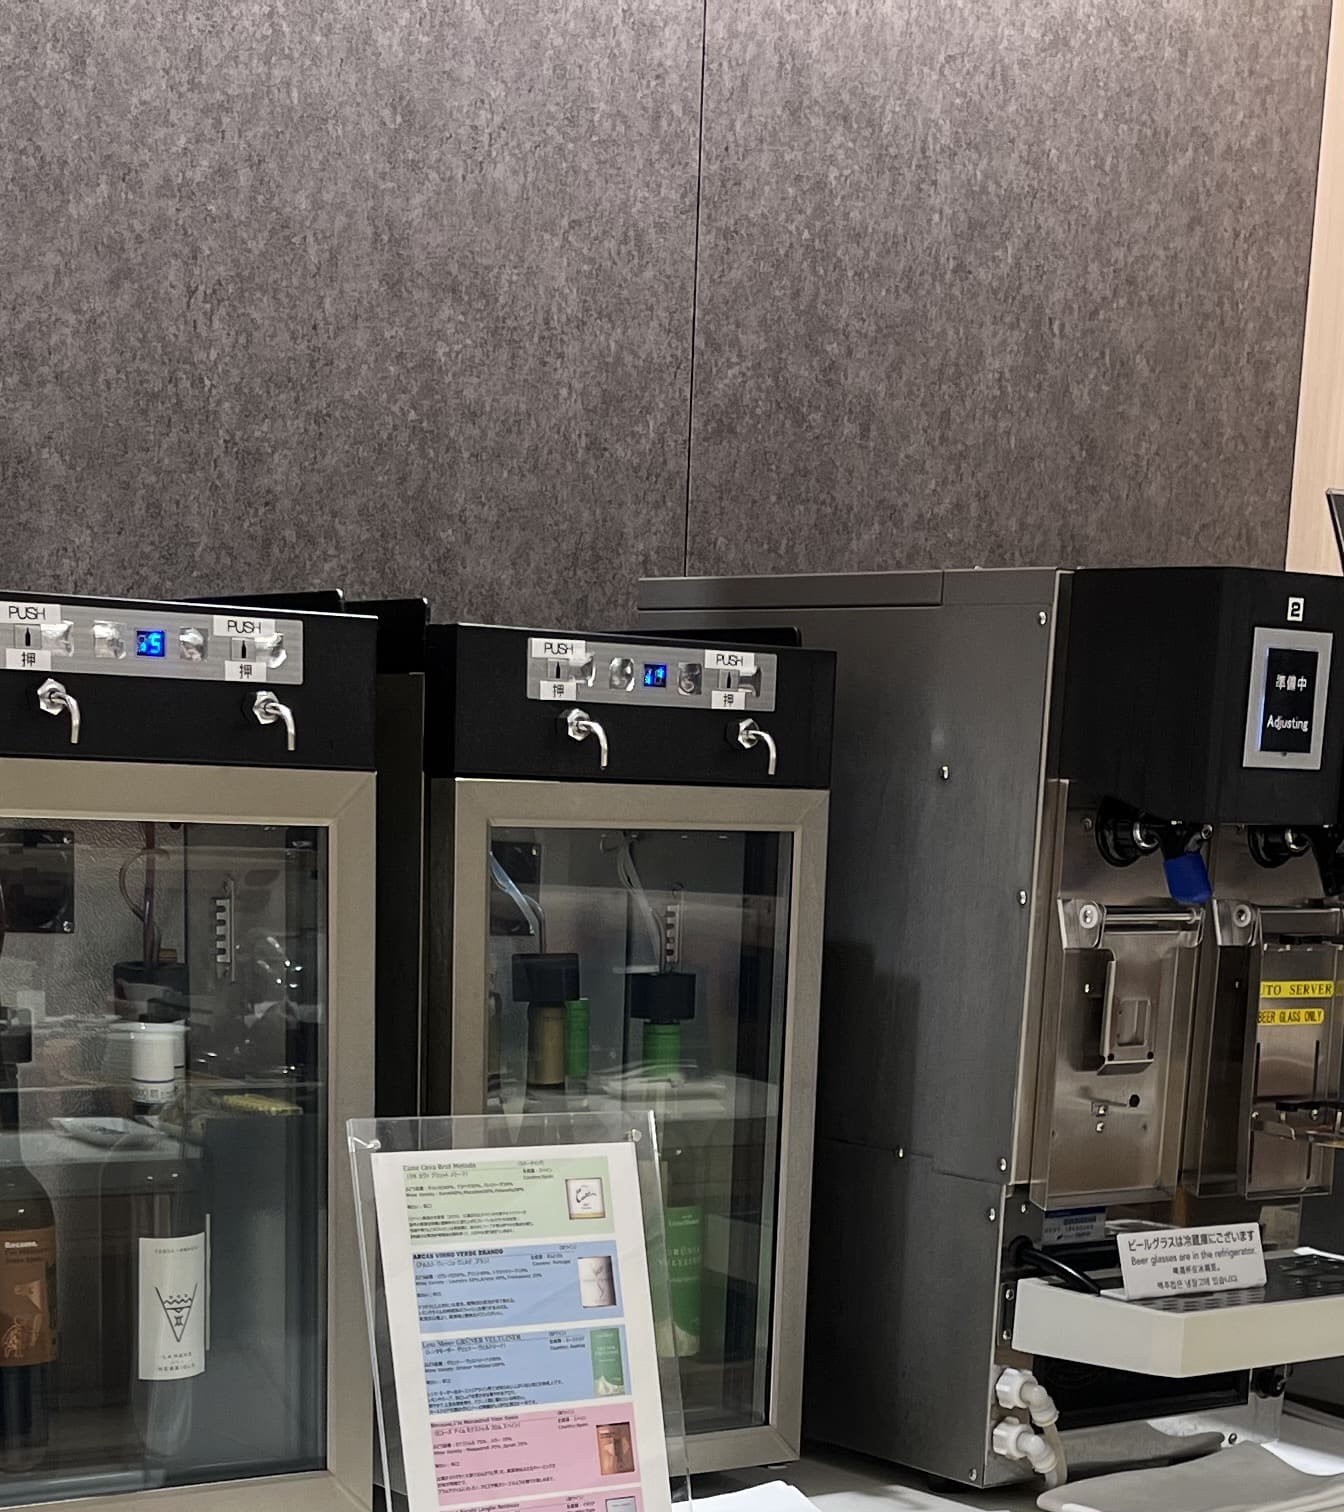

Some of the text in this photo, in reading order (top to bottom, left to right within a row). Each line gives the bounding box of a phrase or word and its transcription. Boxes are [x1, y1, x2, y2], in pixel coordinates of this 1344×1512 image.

[8, 605, 46, 620] PUSH
[1290, 601, 1301, 618] 2
[227, 619, 262, 634] PUSH
[544, 642, 574, 655] PUSH
[21, 651, 36, 667] 押
[716, 653, 744, 667] PUSH
[239, 663, 253, 679] 押
[1275, 673, 1307, 692] 準備中
[1266, 714, 1309, 733] Adjusting
[1288, 983, 1333, 996] SERVER
[1279, 1010, 1301, 1023] GLASS
[1304, 1010, 1322, 1022] ONLY
[1128, 1230, 1255, 1252] ビールグラスは冷蔵庫にございます
[1131, 1255, 1149, 1266] Beer
[1150, 1255, 1178, 1266] glasses
[1179, 1253, 1191, 1261] are
[1192, 1251, 1200, 1260] in
[1200, 1249, 1213, 1259] the
